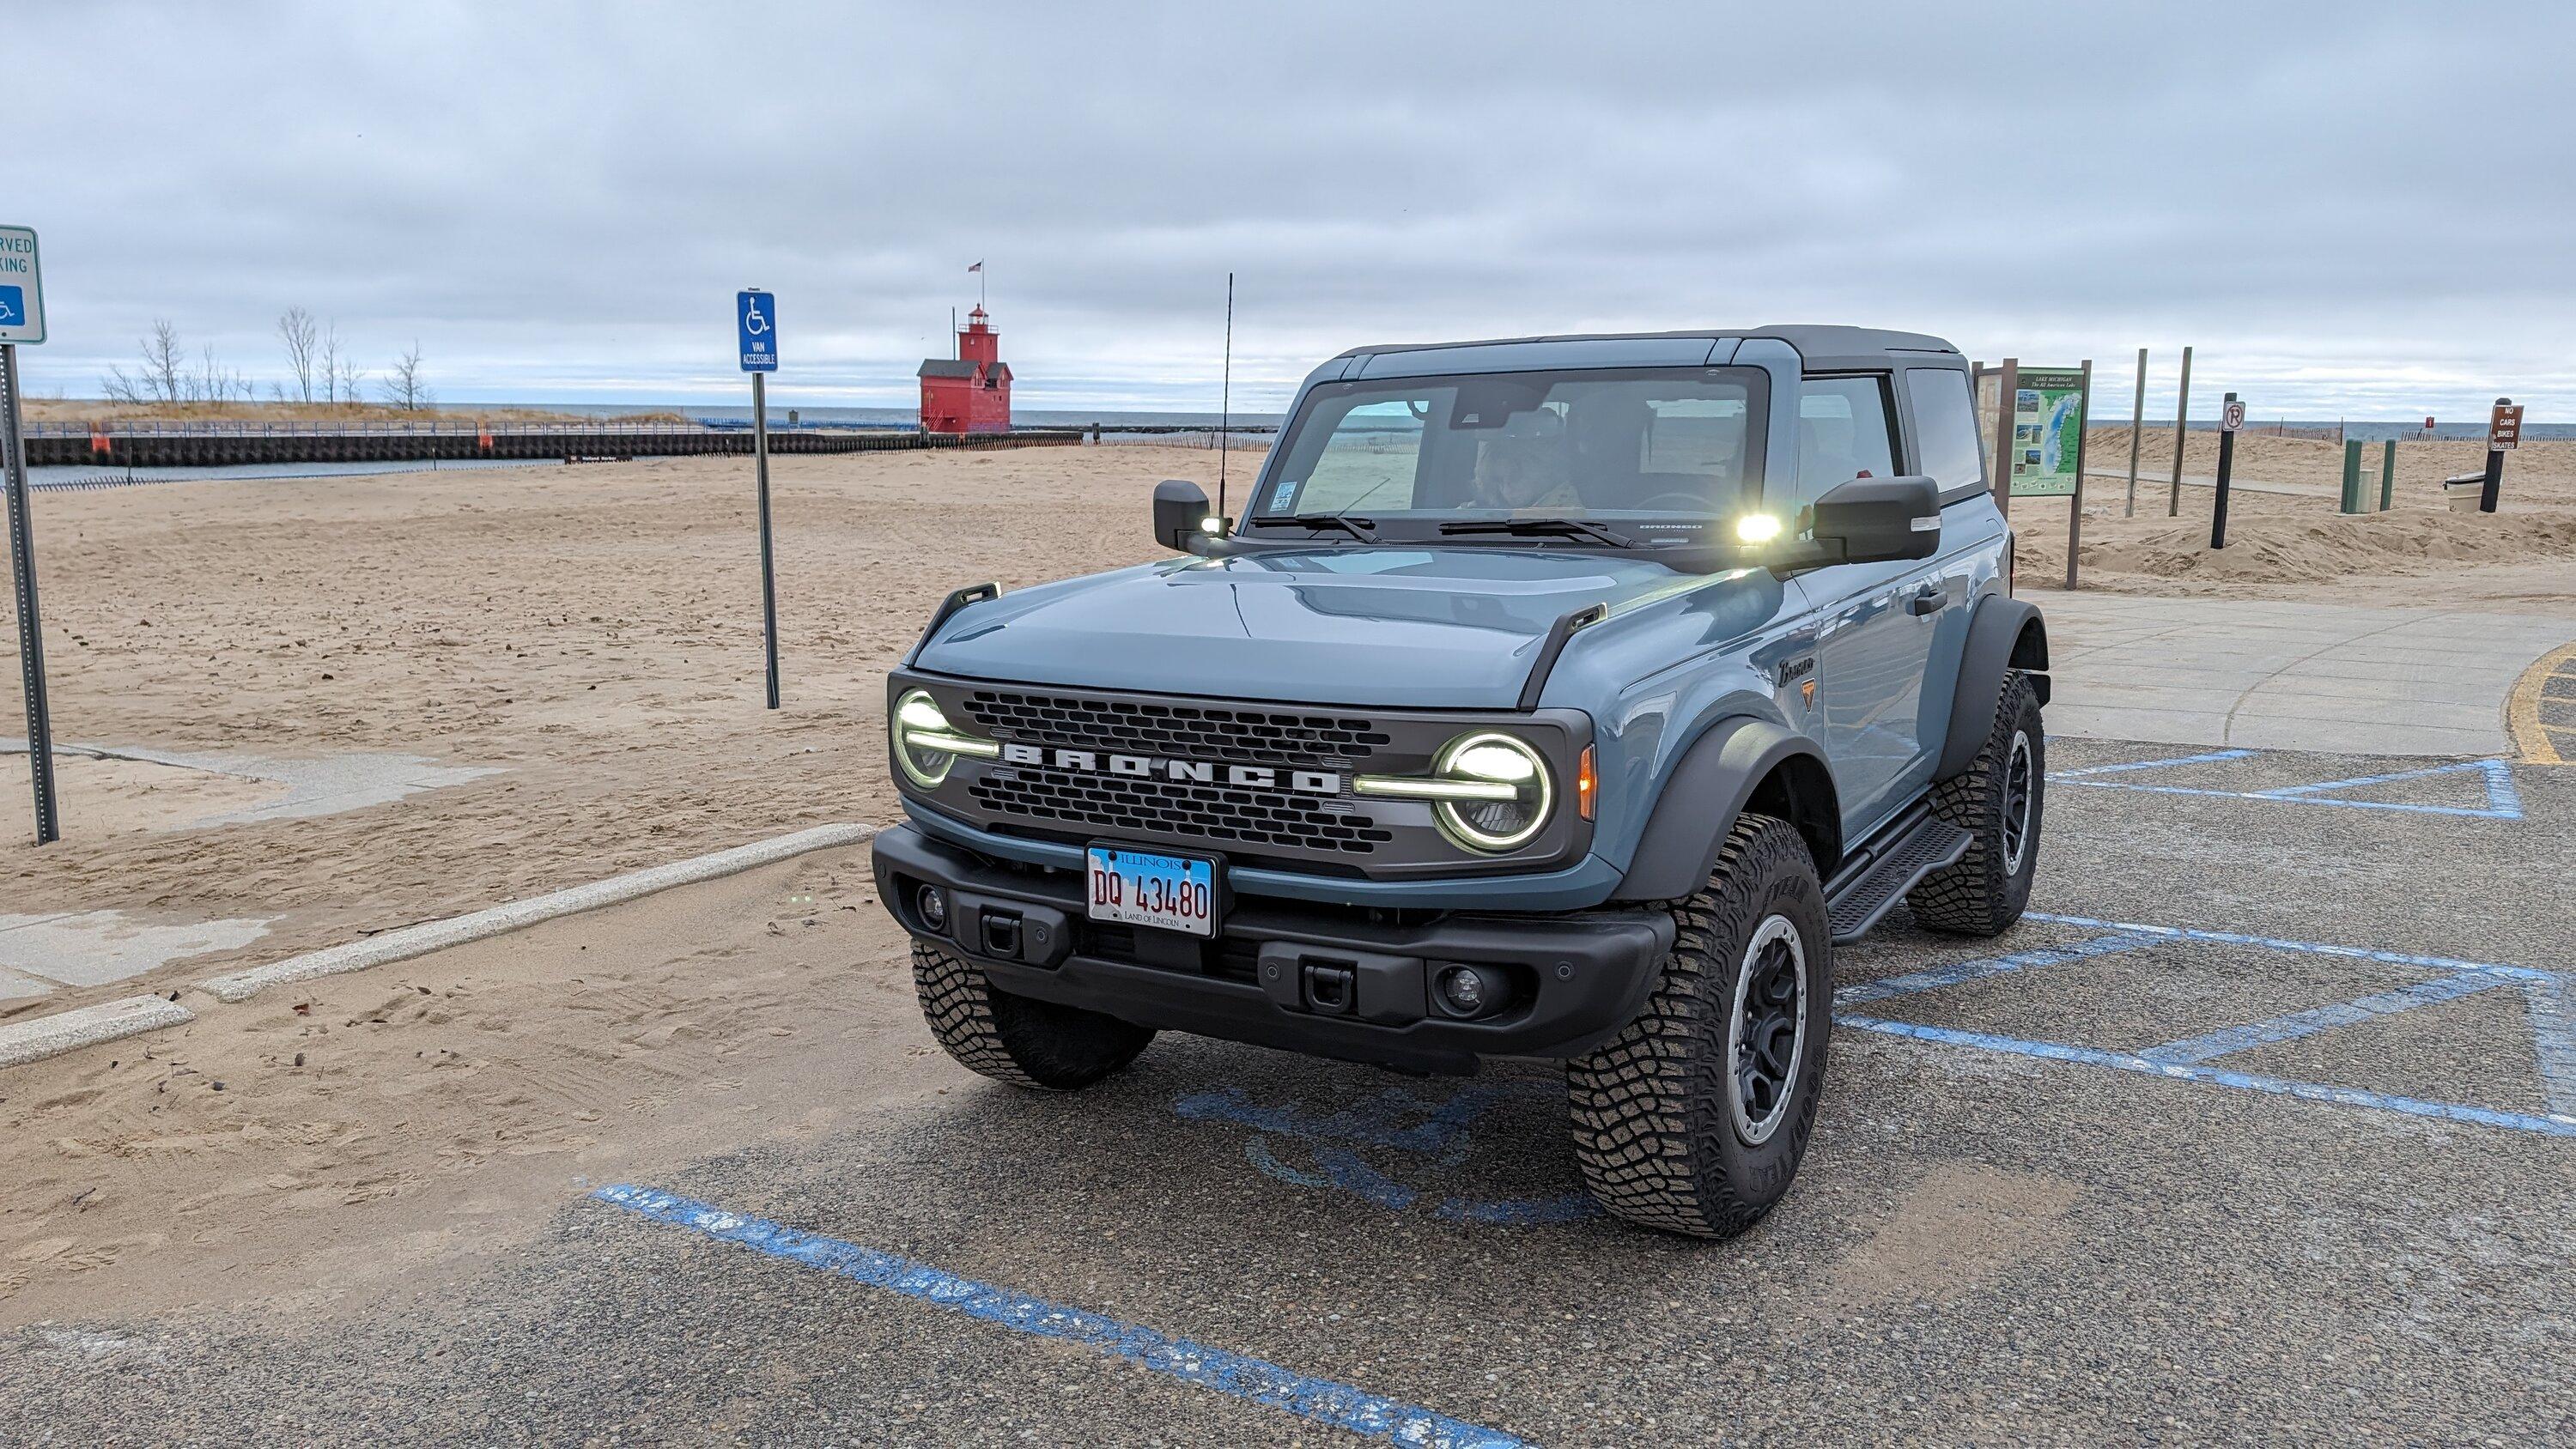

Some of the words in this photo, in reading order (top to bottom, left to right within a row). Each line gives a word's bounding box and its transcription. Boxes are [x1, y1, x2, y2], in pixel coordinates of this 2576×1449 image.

[752, 342, 765, 352] VAN
[743, 354, 775, 364] ACCESSIBLE
[1004, 743, 1340, 794] BRONCO
[1121, 854, 1182, 870] ILLINOIS
[1094, 870, 1122, 906] DQ
[1136, 875, 1207, 919] 43480
[1124, 911, 1142, 921] LAND
[1143, 914, 1152, 923] OF
[1152, 916, 1180, 927] LINCOLN
